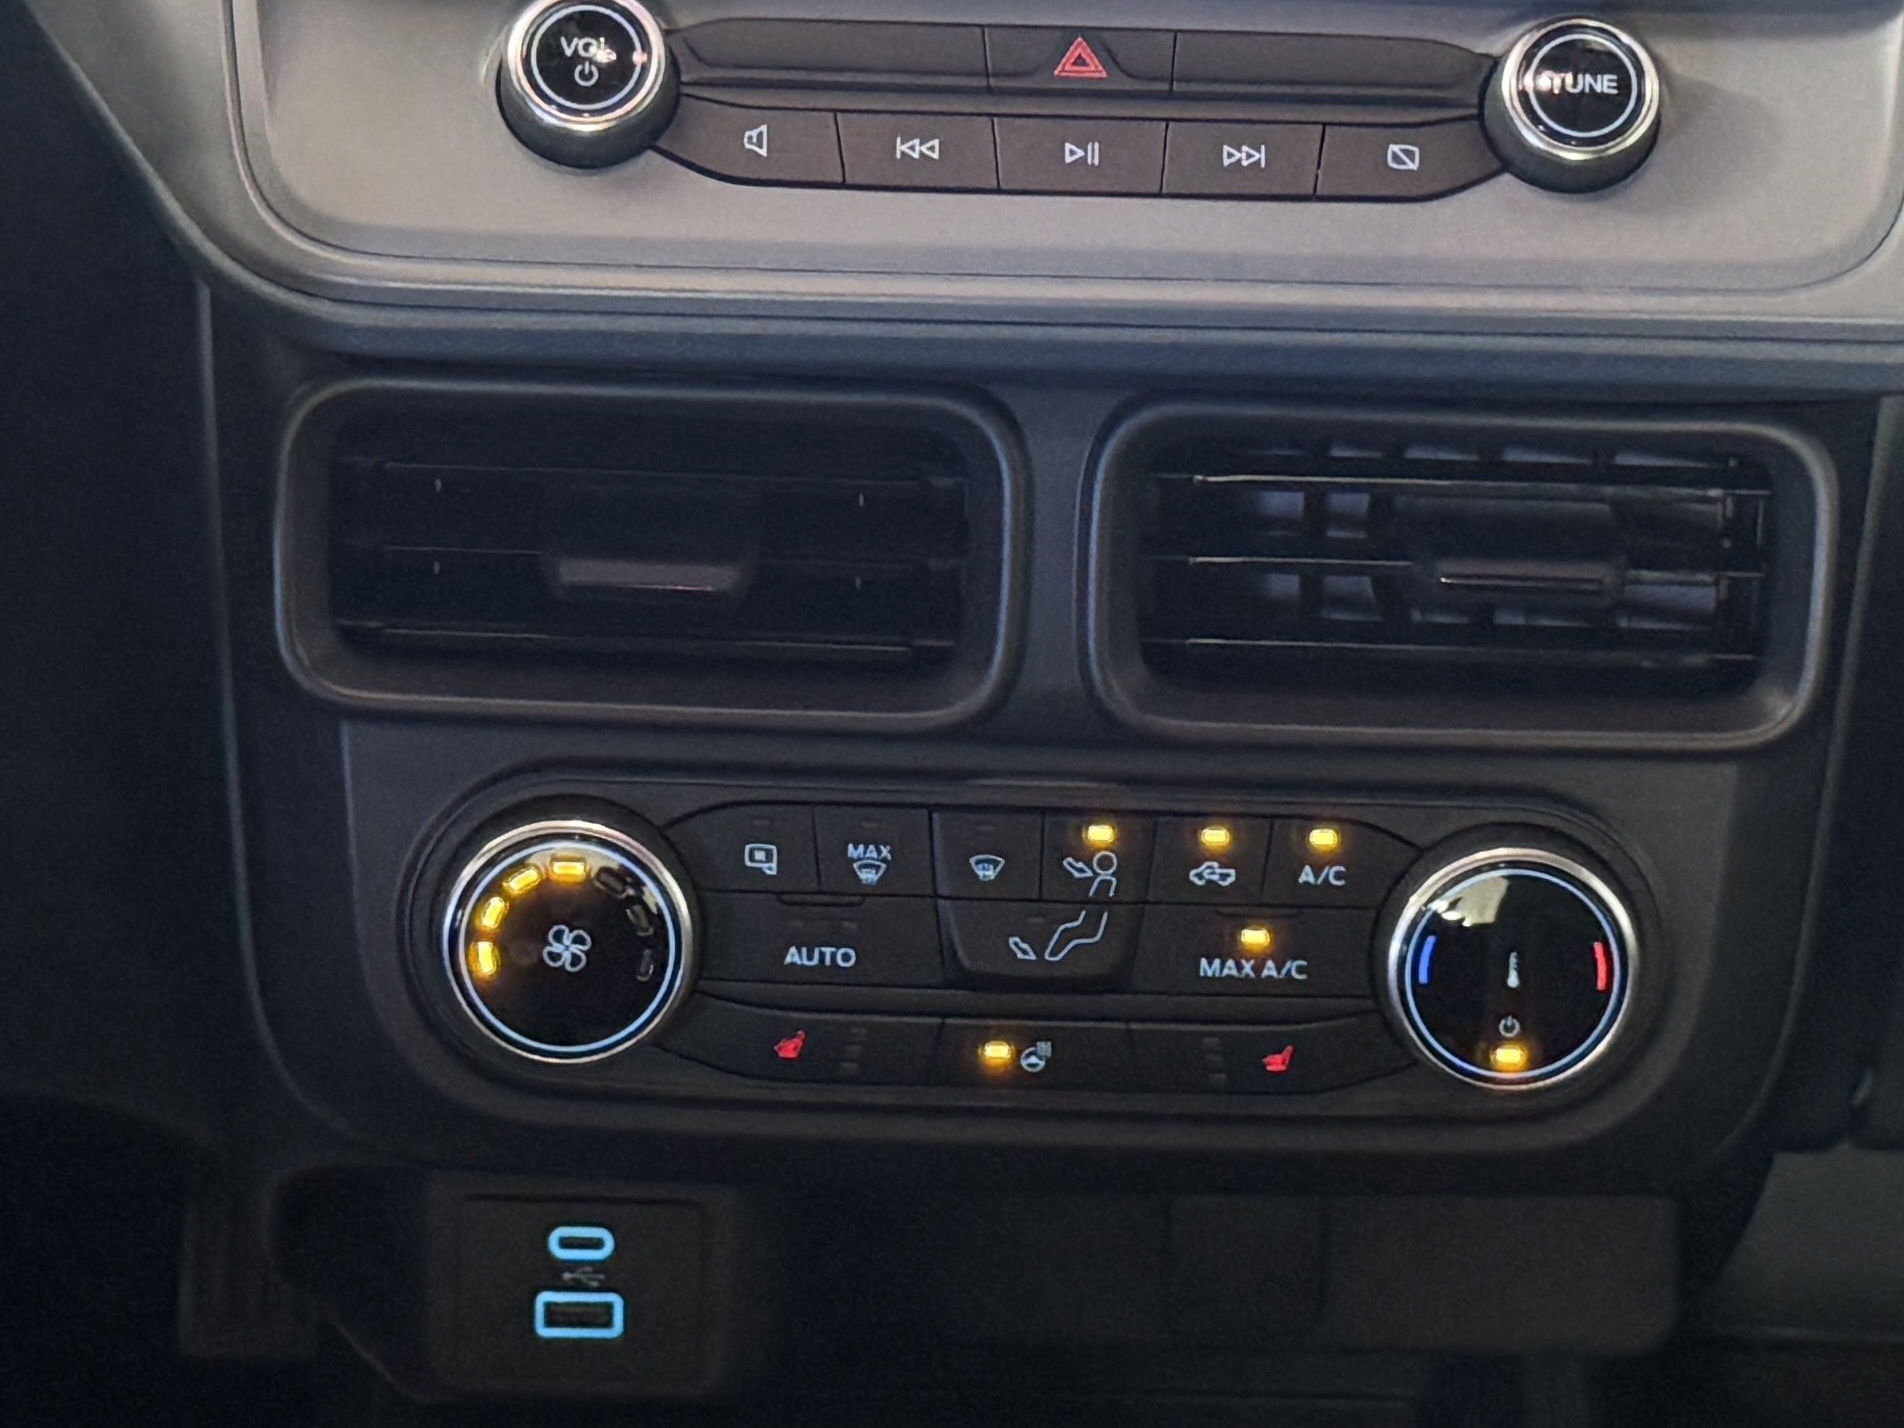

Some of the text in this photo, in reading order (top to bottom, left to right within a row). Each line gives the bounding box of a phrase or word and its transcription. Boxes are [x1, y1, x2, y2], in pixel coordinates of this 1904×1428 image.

[1551, 71, 1618, 95] TUNE
[847, 843, 892, 860] MAX
[1298, 864, 1346, 886] A/C
[783, 945, 857, 968] AUTO
[1199, 957, 1308, 980] MAX A/C
